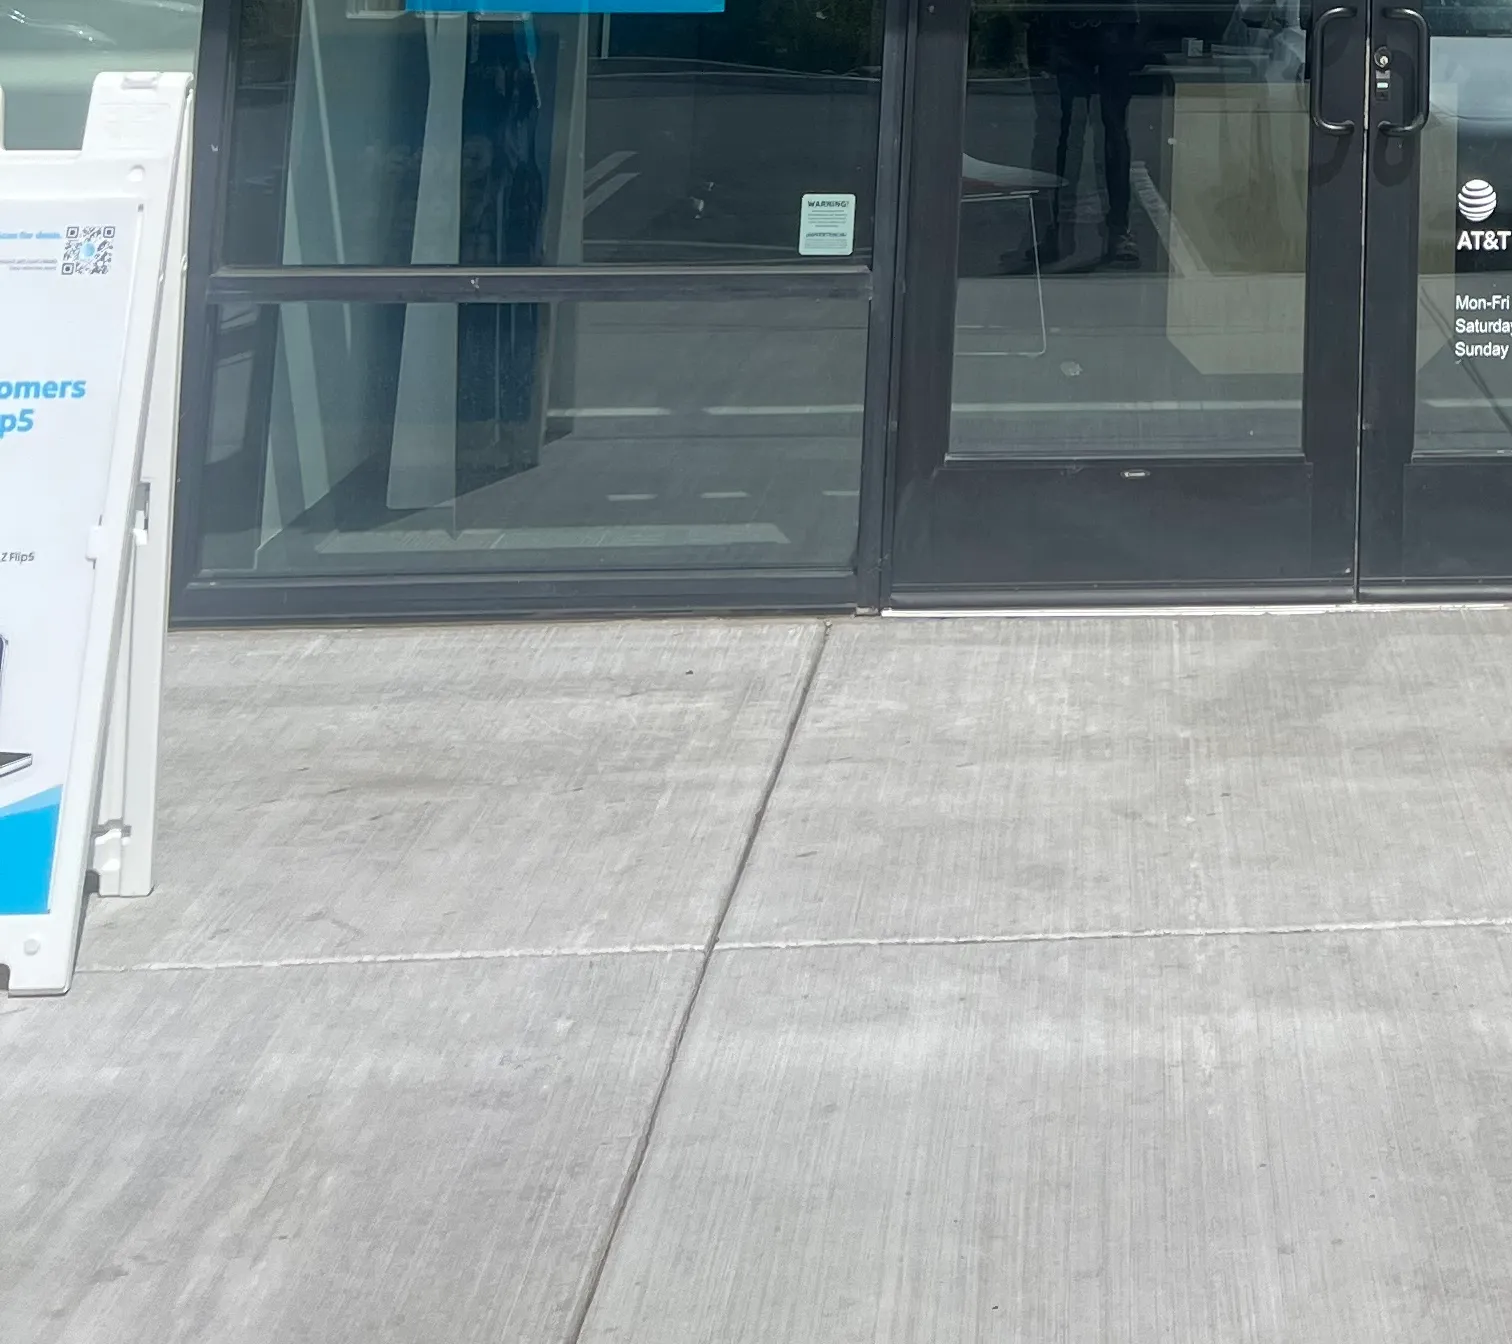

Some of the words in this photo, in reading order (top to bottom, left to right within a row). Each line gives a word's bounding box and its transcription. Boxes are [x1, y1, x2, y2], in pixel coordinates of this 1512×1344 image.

[1456, 230, 1512, 251] AT&T
[1455, 294, 1511, 310] Mon-Fri
[1454, 341, 1510, 359] Sunday
[0, 380, 87, 400] omers
[0, 407, 35, 441] p5
